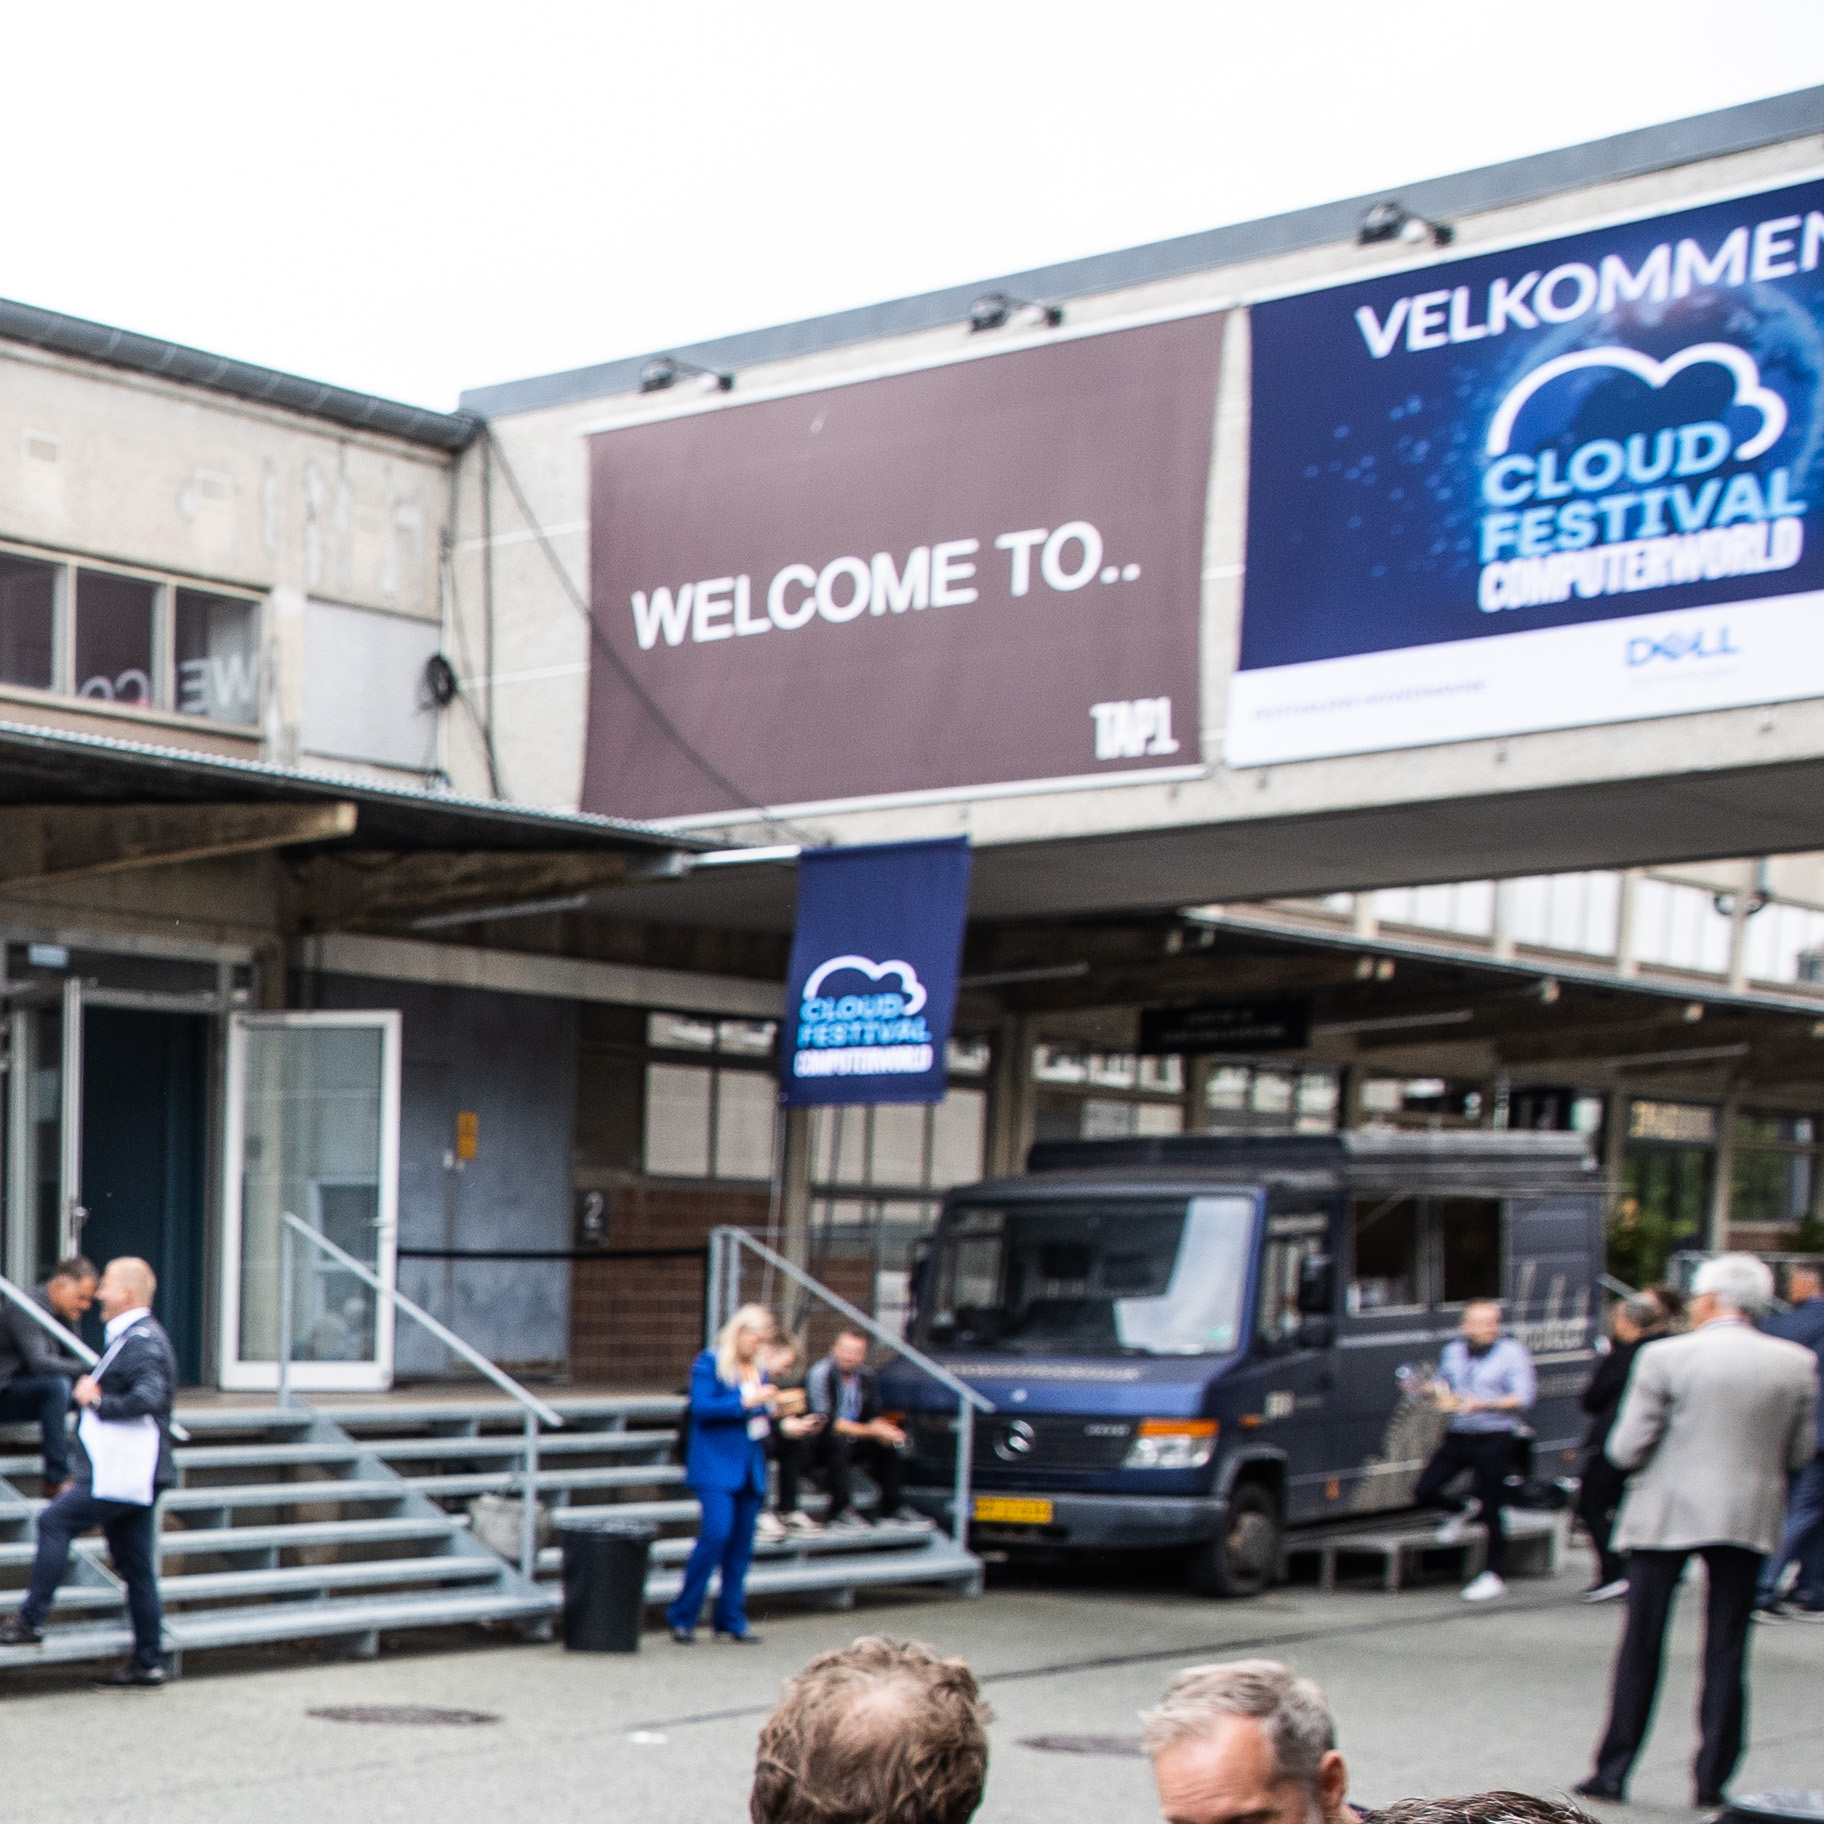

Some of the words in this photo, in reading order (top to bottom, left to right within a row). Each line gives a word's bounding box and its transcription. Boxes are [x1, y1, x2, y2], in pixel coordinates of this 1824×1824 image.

[1483, 422, 1732, 507] CLOUD
[1480, 468, 1806, 563] FESTIVAL
[631, 538, 980, 650] WELCOME
[994, 521, 1142, 597] TO..
[1478, 517, 1804, 613] COMPUTERWORLD
[1625, 624, 1741, 667] DELL
[797, 1015, 932, 1048] FESTIVAL
[799, 992, 904, 1024] CLOUD
